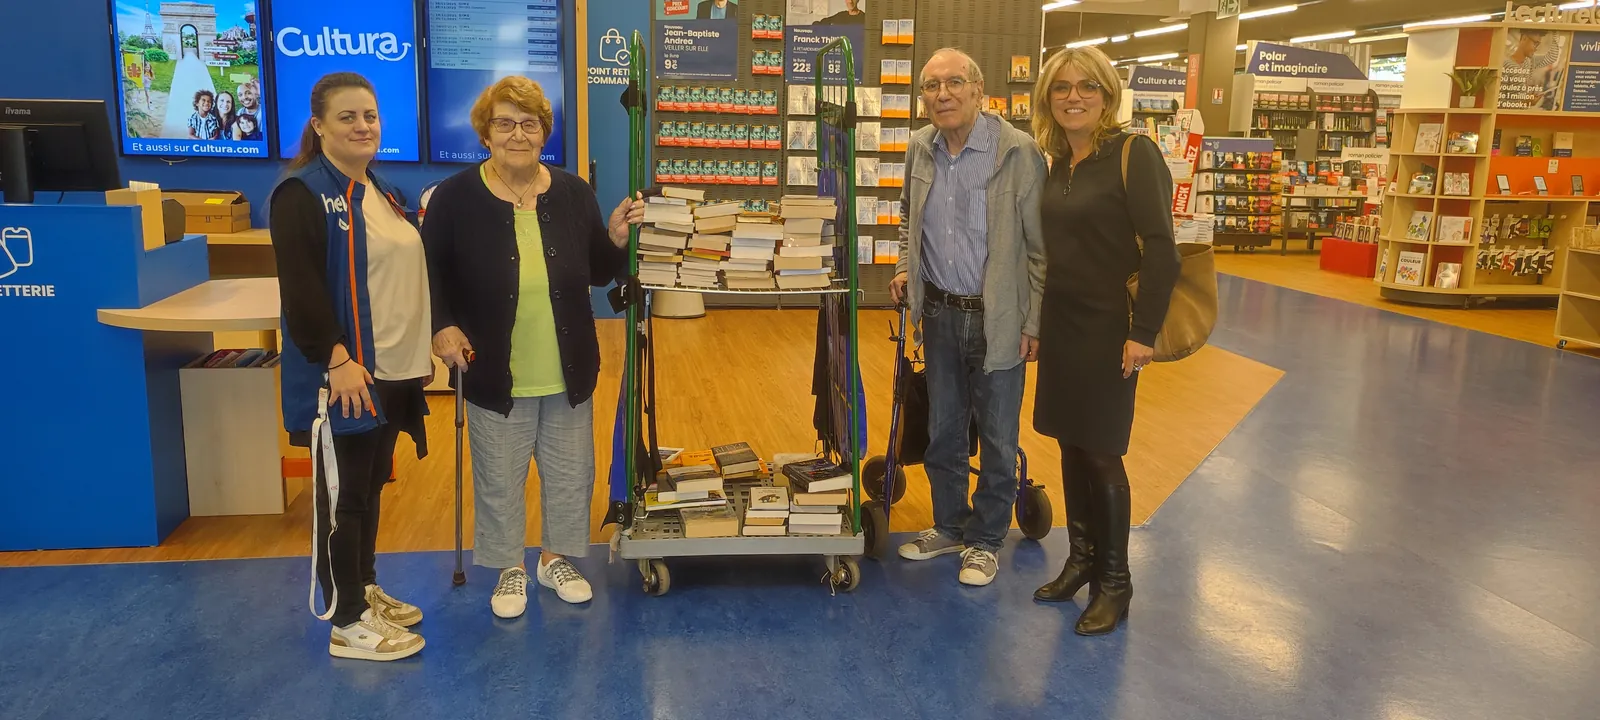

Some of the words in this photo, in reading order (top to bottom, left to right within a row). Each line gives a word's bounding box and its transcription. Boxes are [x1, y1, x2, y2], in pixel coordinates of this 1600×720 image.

[664, 29, 720, 39] Jean-Baptiste
[276, 26, 404, 60] Cultura
[664, 37, 693, 45] Andrea
[793, 35, 820, 43] Franck
[1259, 51, 1287, 61] Polar
[1258, 62, 1270, 72] et
[1271, 62, 1328, 75] imaginaire
[1137, 76, 1167, 85] Culture
[1527, 85, 1543, 93] près
[1510, 92, 1535, 100] million
[5, 106, 32, 115] iiyama
[132, 142, 143, 151] Et
[145, 143, 171, 152] aussi
[192, 144, 259, 154] Cultura.com
[439, 150, 449, 159] Et
[451, 151, 475, 160] aussi
